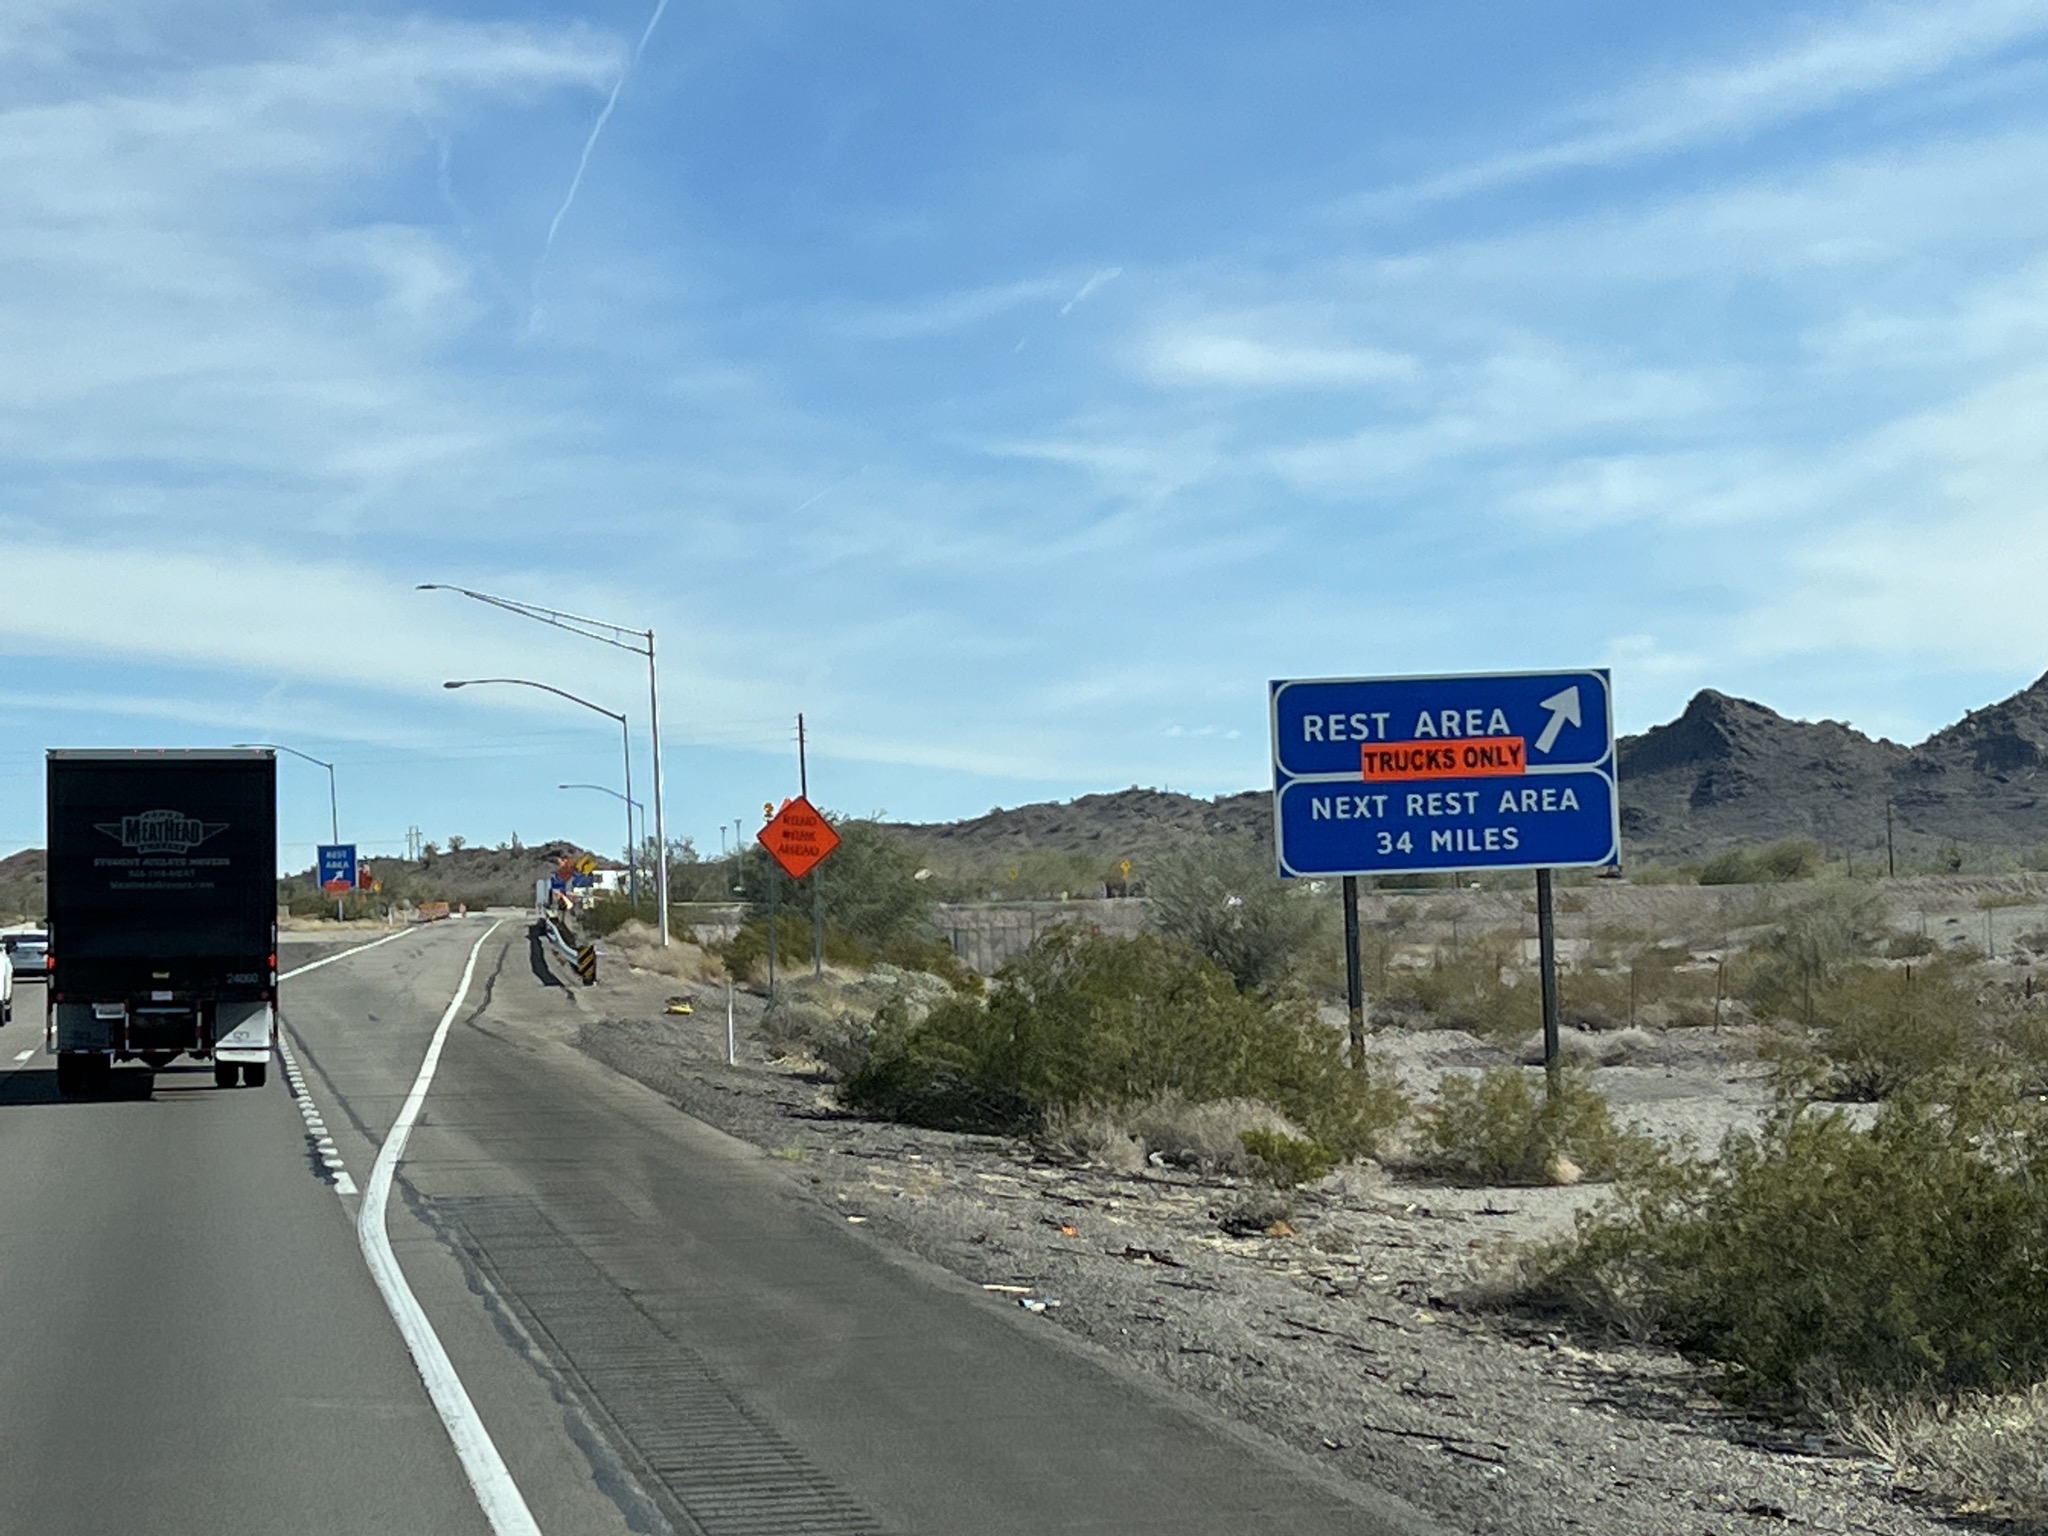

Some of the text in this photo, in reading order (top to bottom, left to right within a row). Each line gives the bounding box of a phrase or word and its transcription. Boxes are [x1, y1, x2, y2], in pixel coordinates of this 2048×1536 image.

[1303, 708, 1510, 742] REST AREA
[1363, 743, 1522, 773] TRUCKS ONLY
[1311, 788, 1580, 820] NEXT REST AREA
[326, 850, 347, 859] REST
[1376, 827, 1519, 855] 34 MILES
[325, 861, 350, 869] AREA
